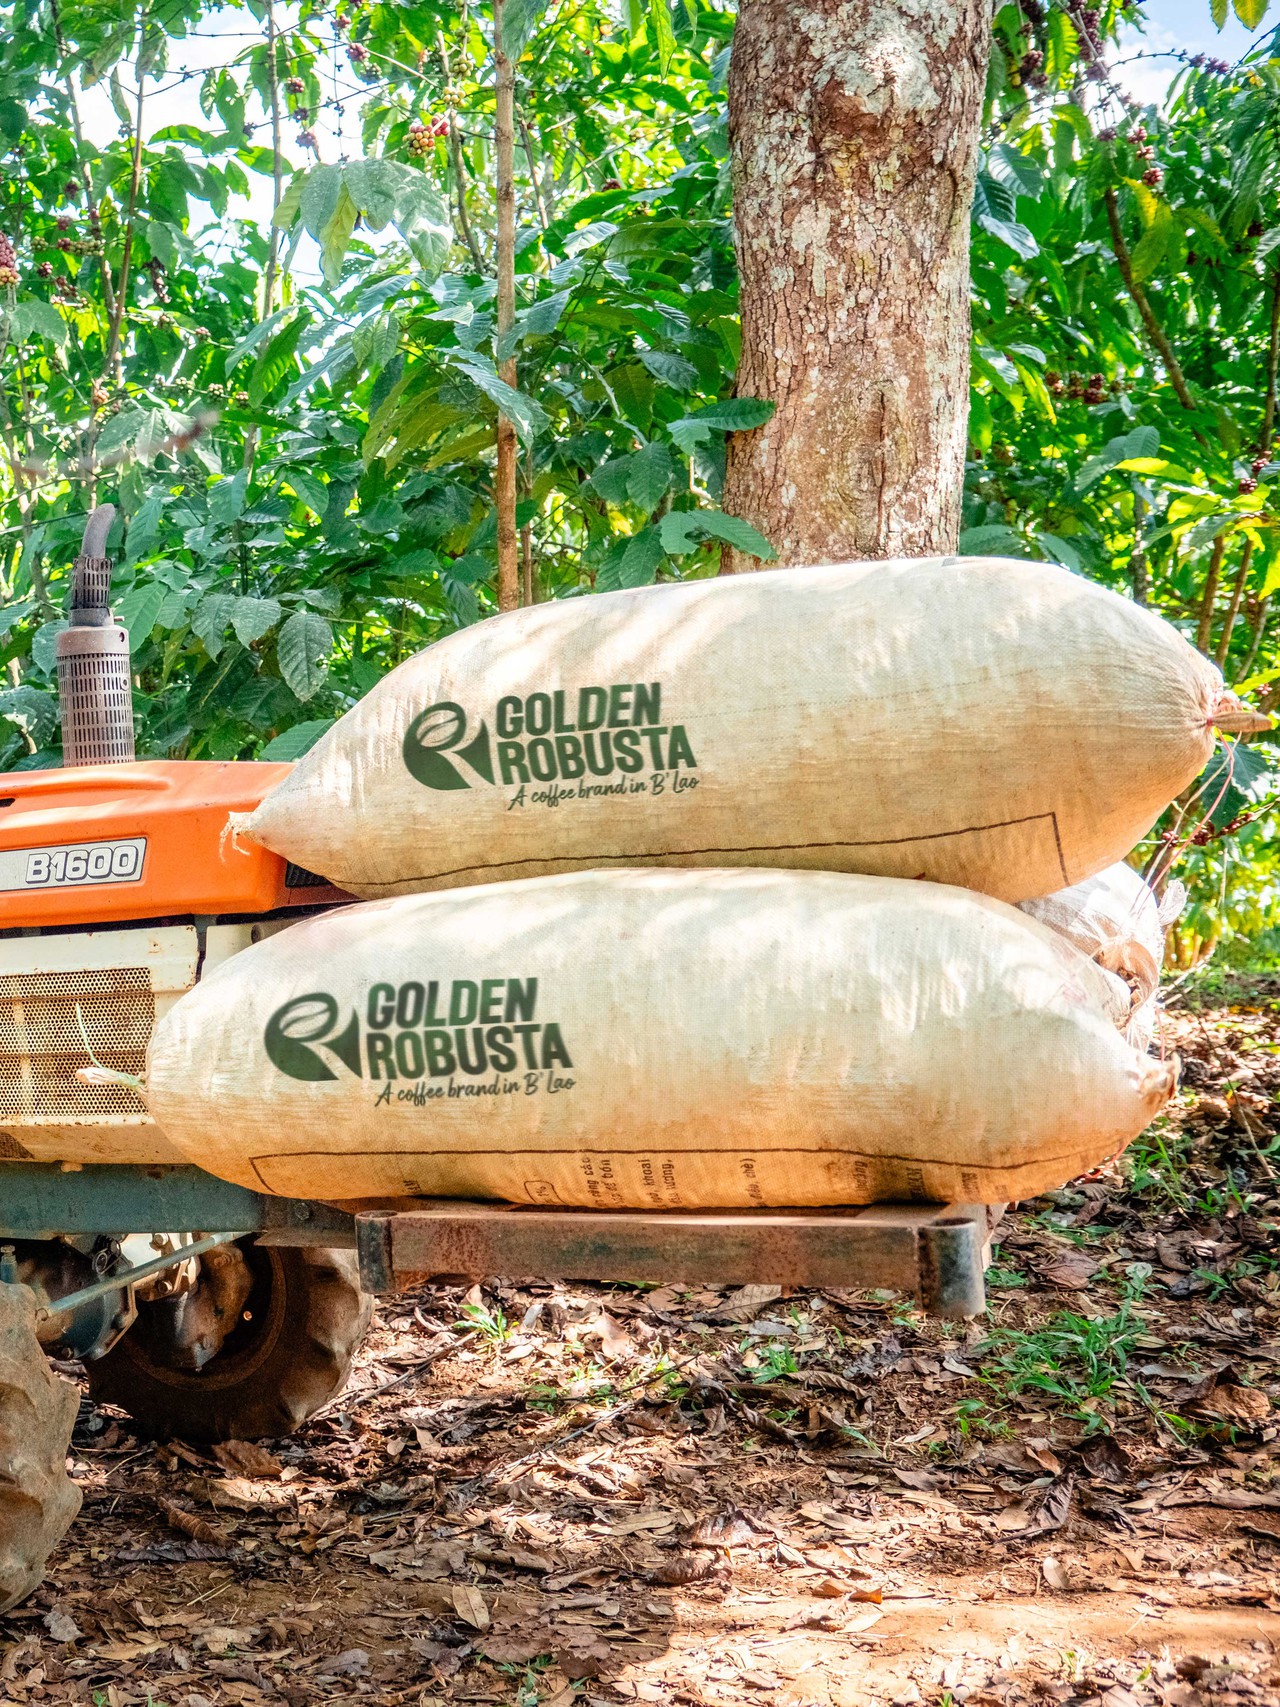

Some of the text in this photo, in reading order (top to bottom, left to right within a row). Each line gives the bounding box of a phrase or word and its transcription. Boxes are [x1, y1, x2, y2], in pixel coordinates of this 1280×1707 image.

[496, 682, 661, 739] GOLDEN
[496, 725, 697, 785] ROBUSTA
[507, 785, 528, 811] A
[531, 784, 575, 808] coffee
[577, 775, 628, 798] brand
[629, 778, 647, 793] in
[25, 845, 139, 885] B1600
[367, 977, 538, 1030] GOLDEN
[366, 1023, 574, 1080] ROBUSTA
[374, 1082, 394, 1107] A
[397, 1082, 445, 1107] coffee
[447, 1074, 500, 1097] brand
[502, 1078, 520, 1093] in
[638, 1159, 655, 1186] khoai
